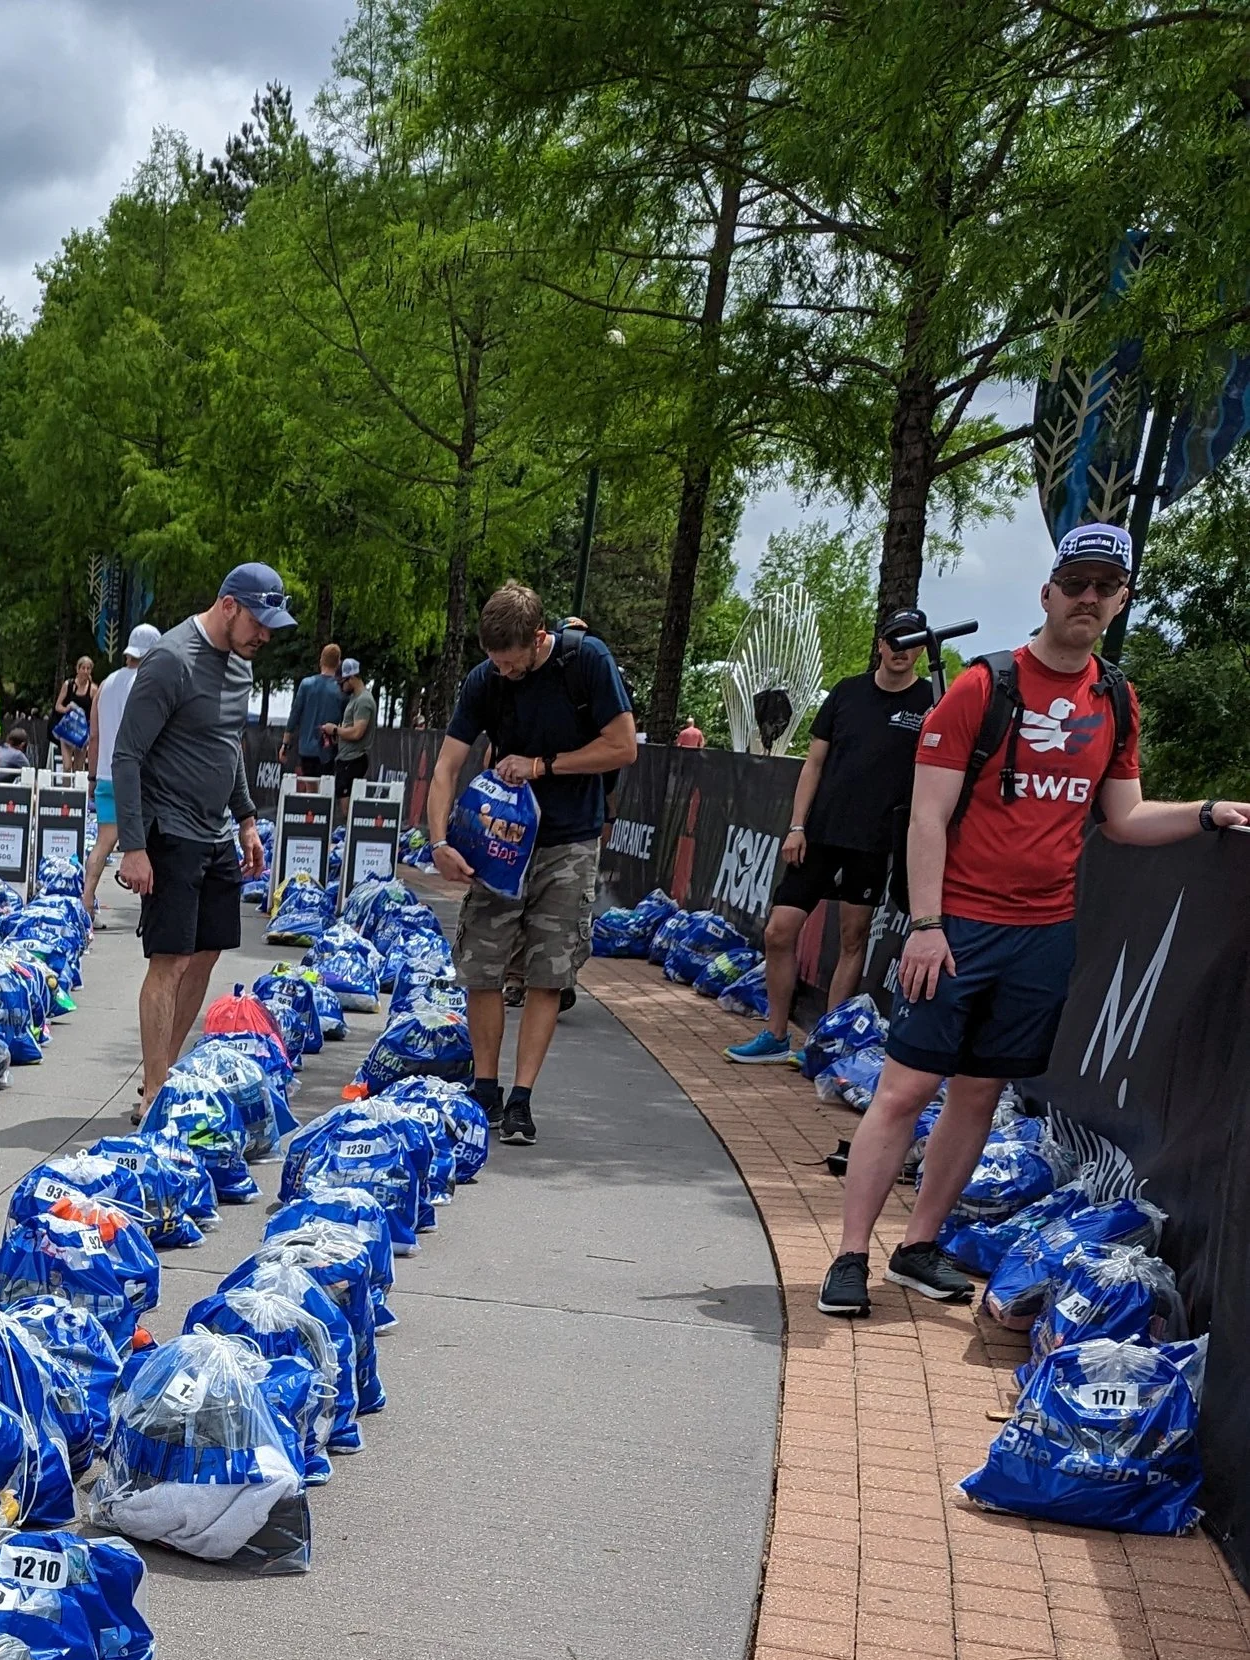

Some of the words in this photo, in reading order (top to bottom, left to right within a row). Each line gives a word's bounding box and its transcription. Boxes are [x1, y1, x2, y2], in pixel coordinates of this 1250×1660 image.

[477, 780, 497, 795] 1243
[40, 804, 83, 818] IRONMAN
[284, 808, 328, 825] IRONMAN
[353, 814, 397, 828] IRONMAN
[606, 817, 656, 860] DURANCE
[292, 856, 310, 864] 1001
[361, 859, 379, 867] 1301
[712, 824, 781, 919] HOKA
[369, 1062, 394, 1082] Bike
[181, 1103, 198, 1115] 94
[346, 1144, 371, 1155] 1230
[452, 1142, 481, 1166] Bag
[117, 1157, 138, 1171] 938
[1091, 1389, 1127, 1406] 1717
[1002, 1425, 1052, 1469] Bike
[1059, 1454, 1141, 1483] Gear
[13, 1555, 61, 1584] 1210
